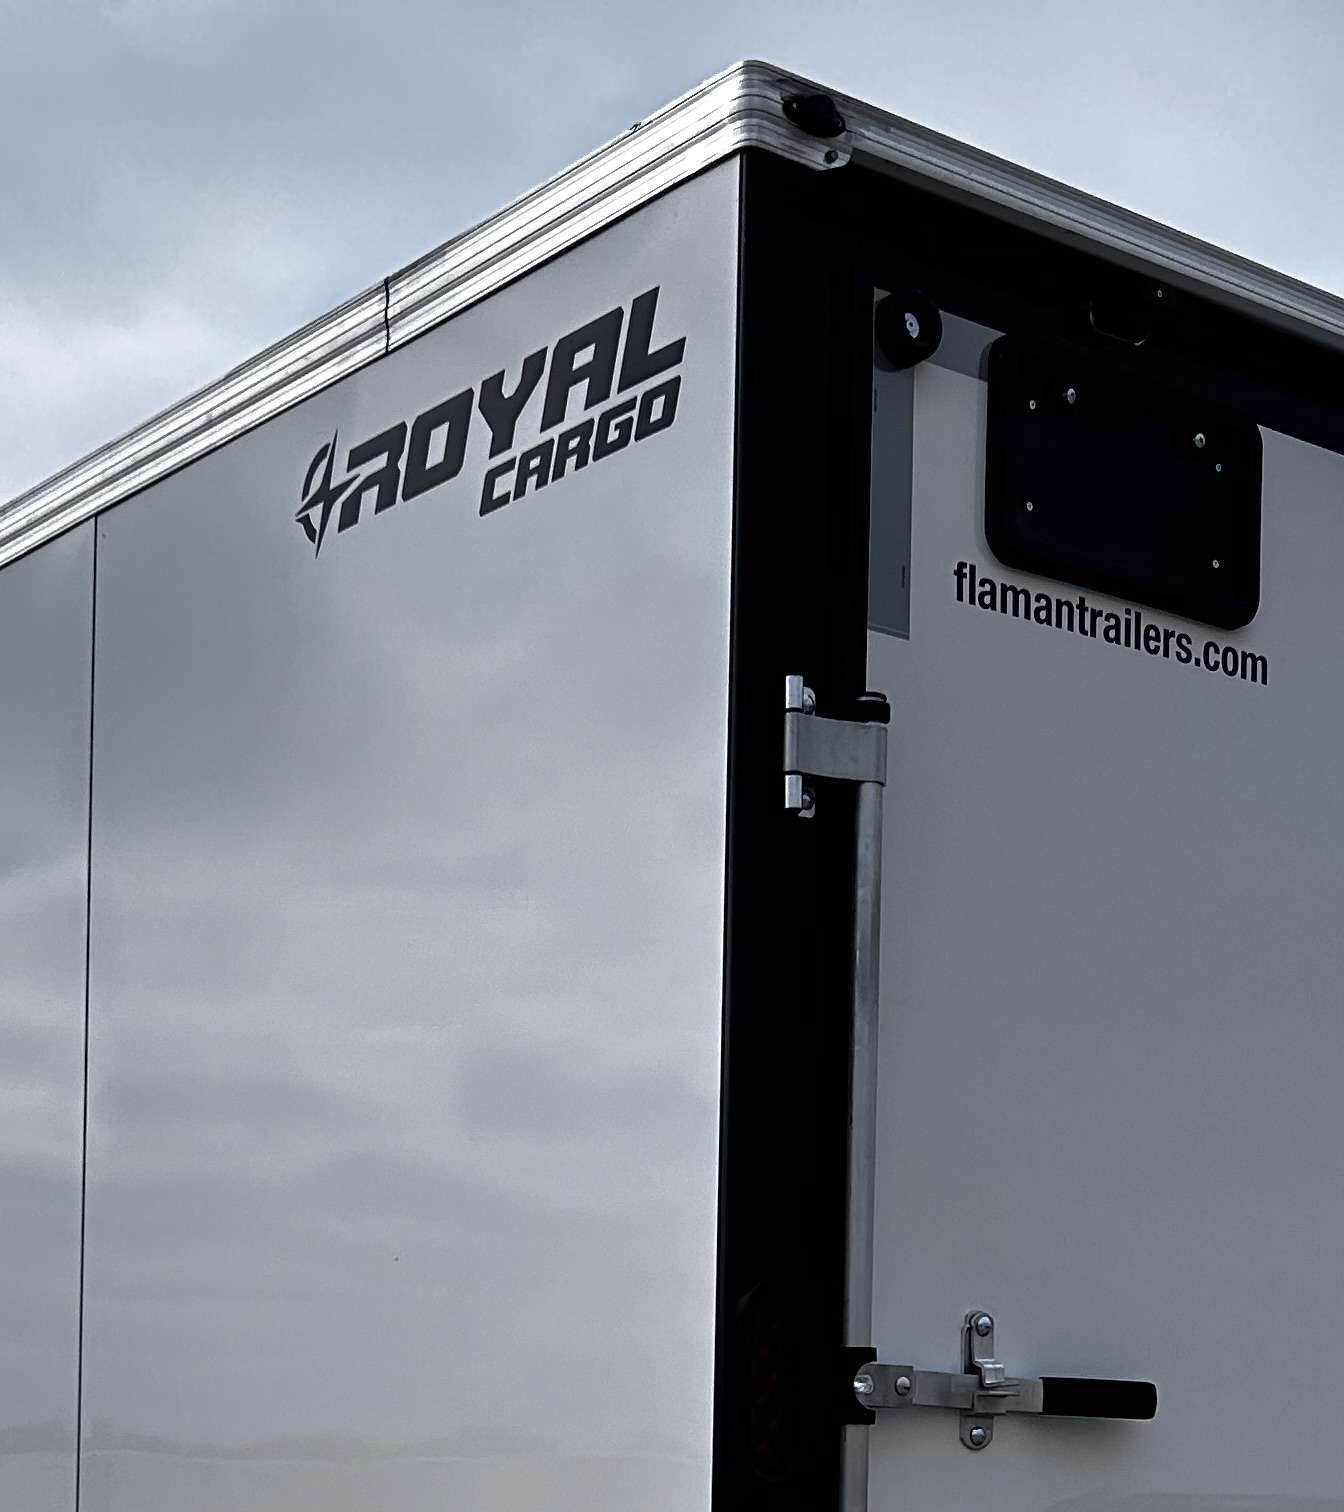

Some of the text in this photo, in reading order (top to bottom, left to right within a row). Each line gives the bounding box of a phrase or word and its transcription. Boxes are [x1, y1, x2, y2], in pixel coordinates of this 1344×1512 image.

[338, 285, 687, 533] ROYAL
[479, 375, 682, 517] CARGO
[953, 561, 1268, 686] flamantrailers.com
